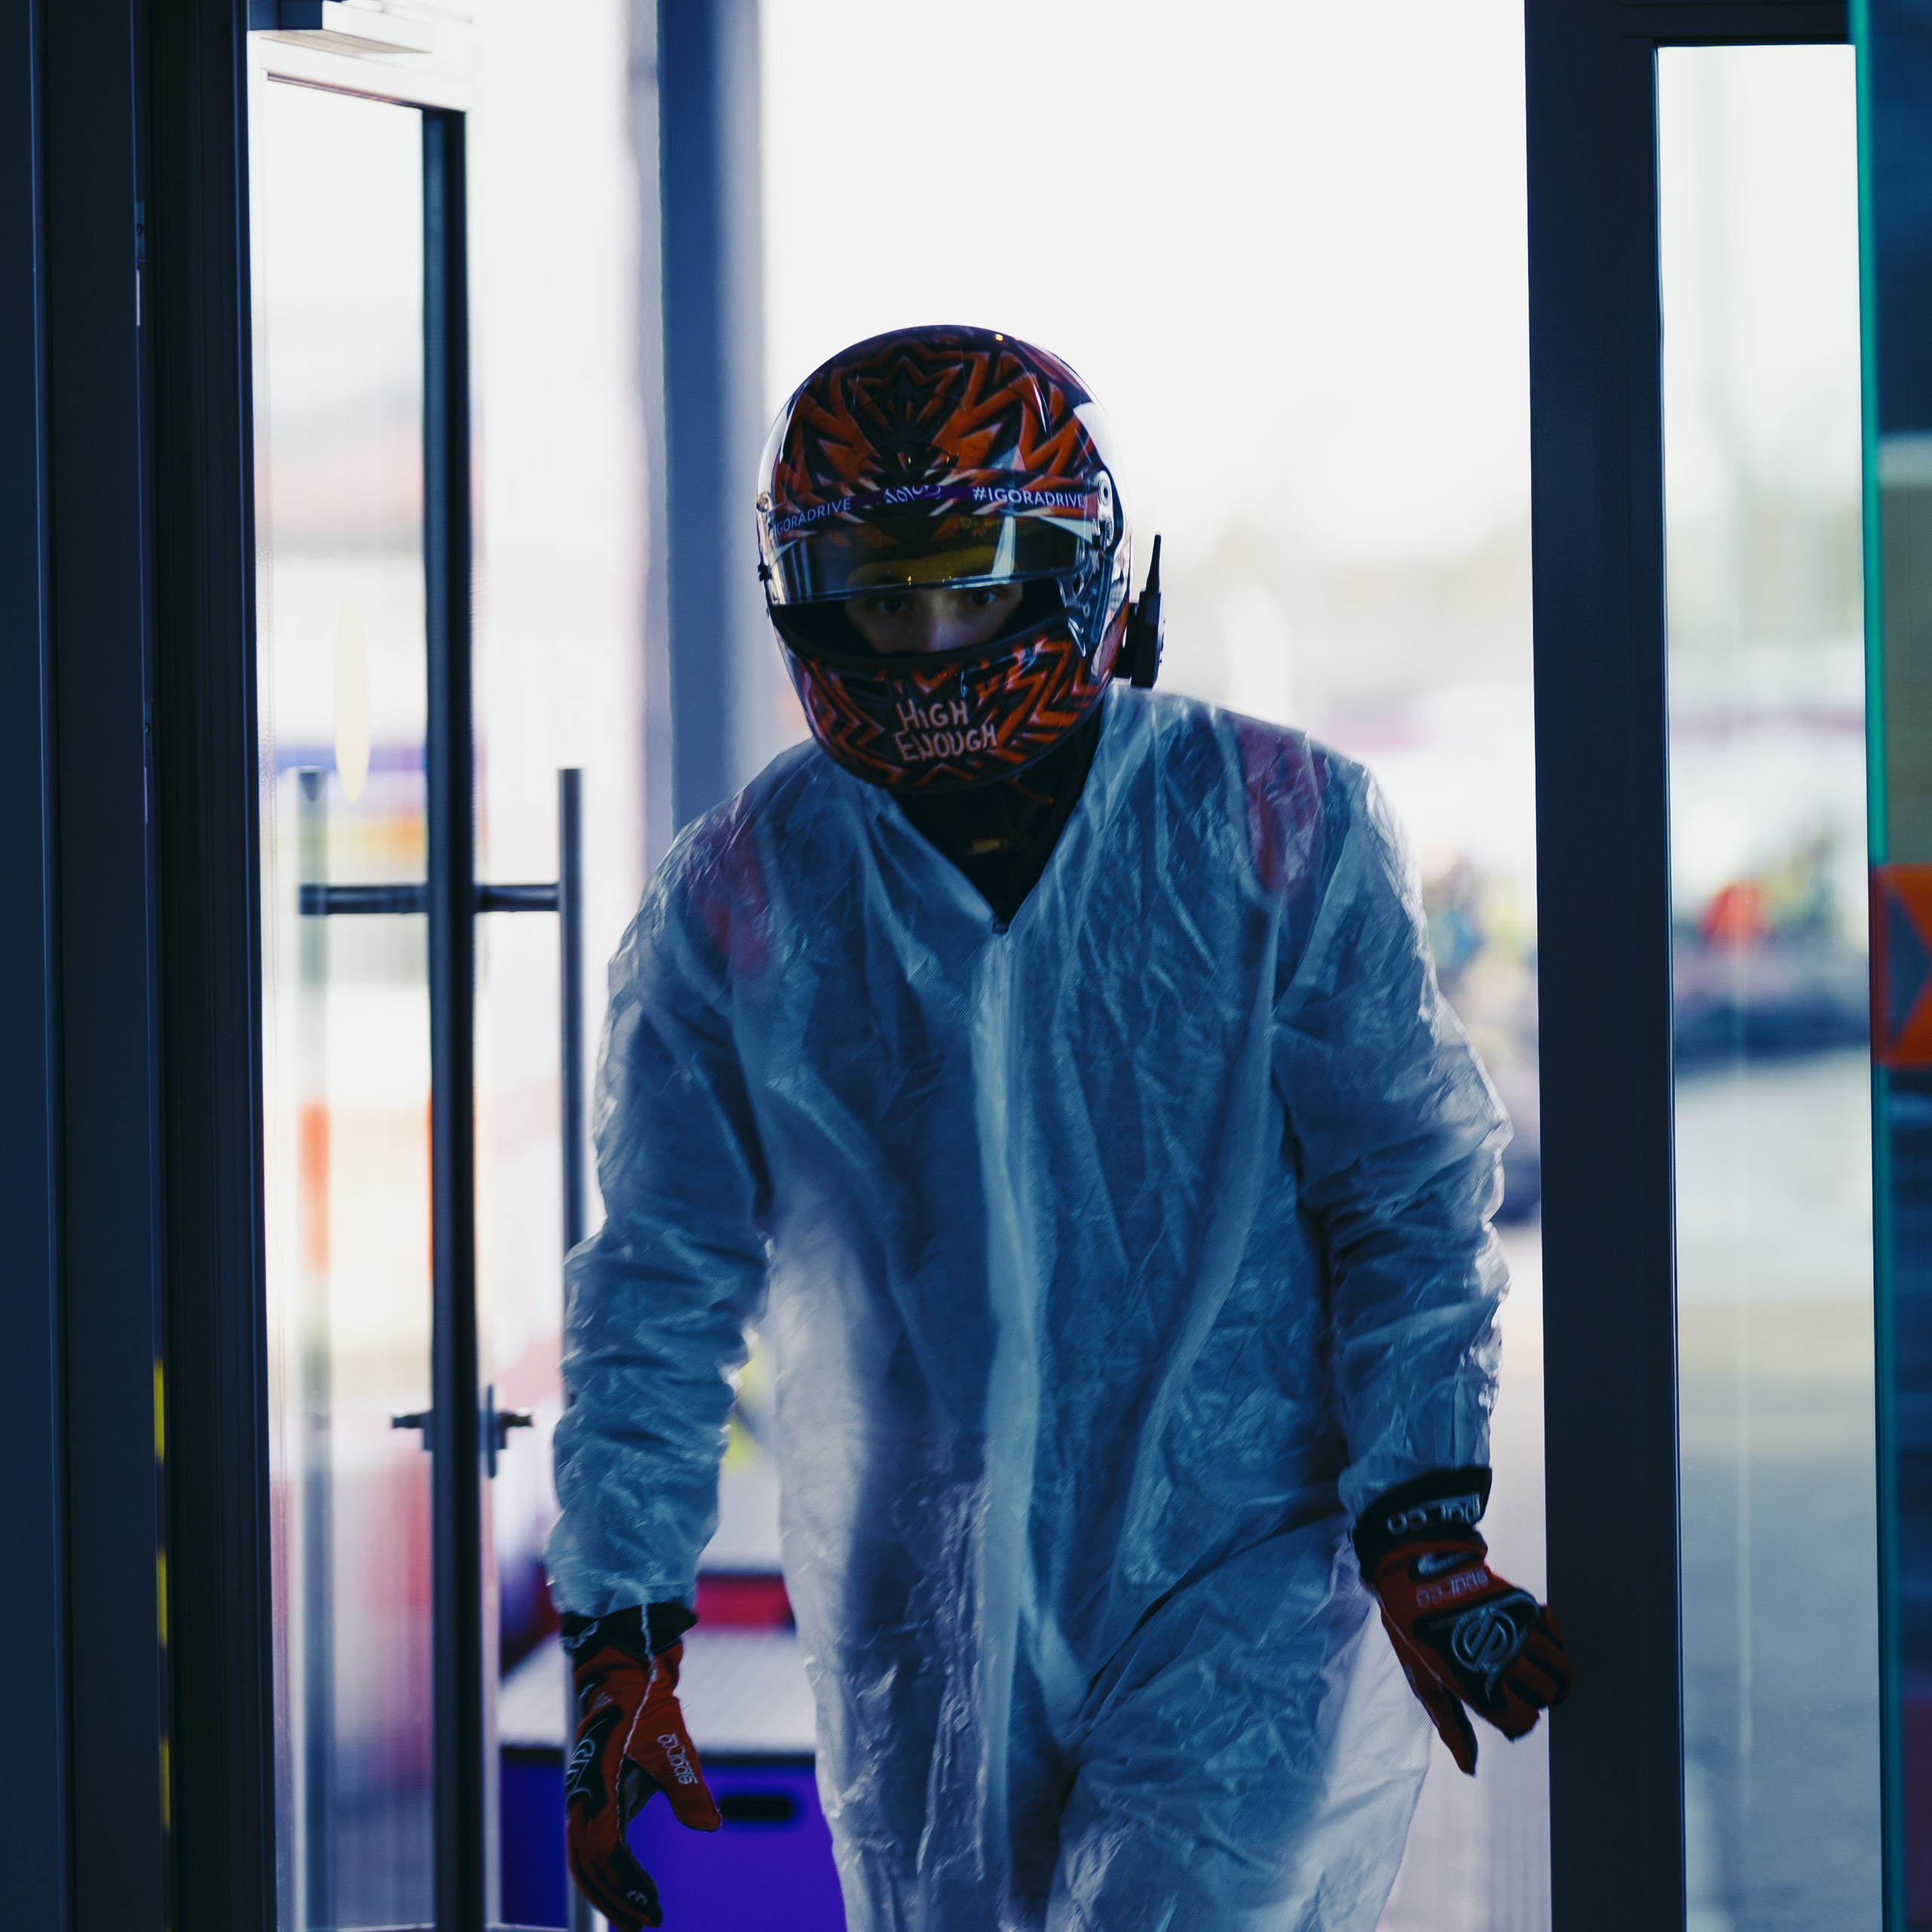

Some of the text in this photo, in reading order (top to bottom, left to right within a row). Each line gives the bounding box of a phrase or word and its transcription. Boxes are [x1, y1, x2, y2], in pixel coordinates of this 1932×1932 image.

[972, 486, 1084, 509] #IGORADRIVE
[895, 698, 968, 731] HIGH
[893, 722, 997, 762] ENOUGH
[1386, 1493, 1480, 1535] parco
